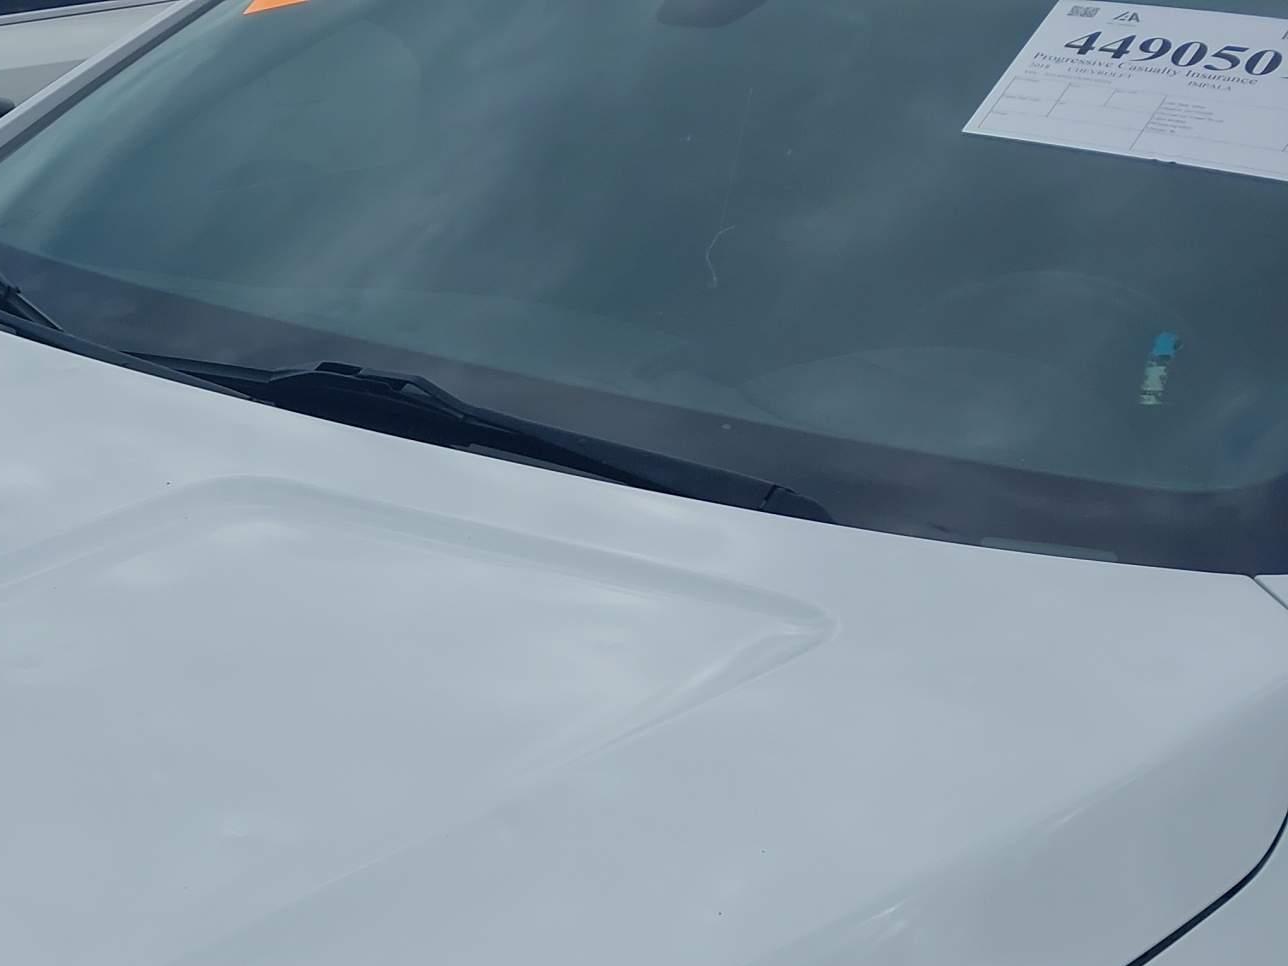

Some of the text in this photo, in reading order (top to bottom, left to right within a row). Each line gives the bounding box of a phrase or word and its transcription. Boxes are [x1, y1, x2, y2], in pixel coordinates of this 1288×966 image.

[1033, 51, 1114, 68] Progressive
[1118, 62, 1179, 77] Casualty
[1186, 70, 1258, 85] Insurance
[1064, 31, 1288, 78] 449050
[1188, 81, 1232, 91] IMPALA
